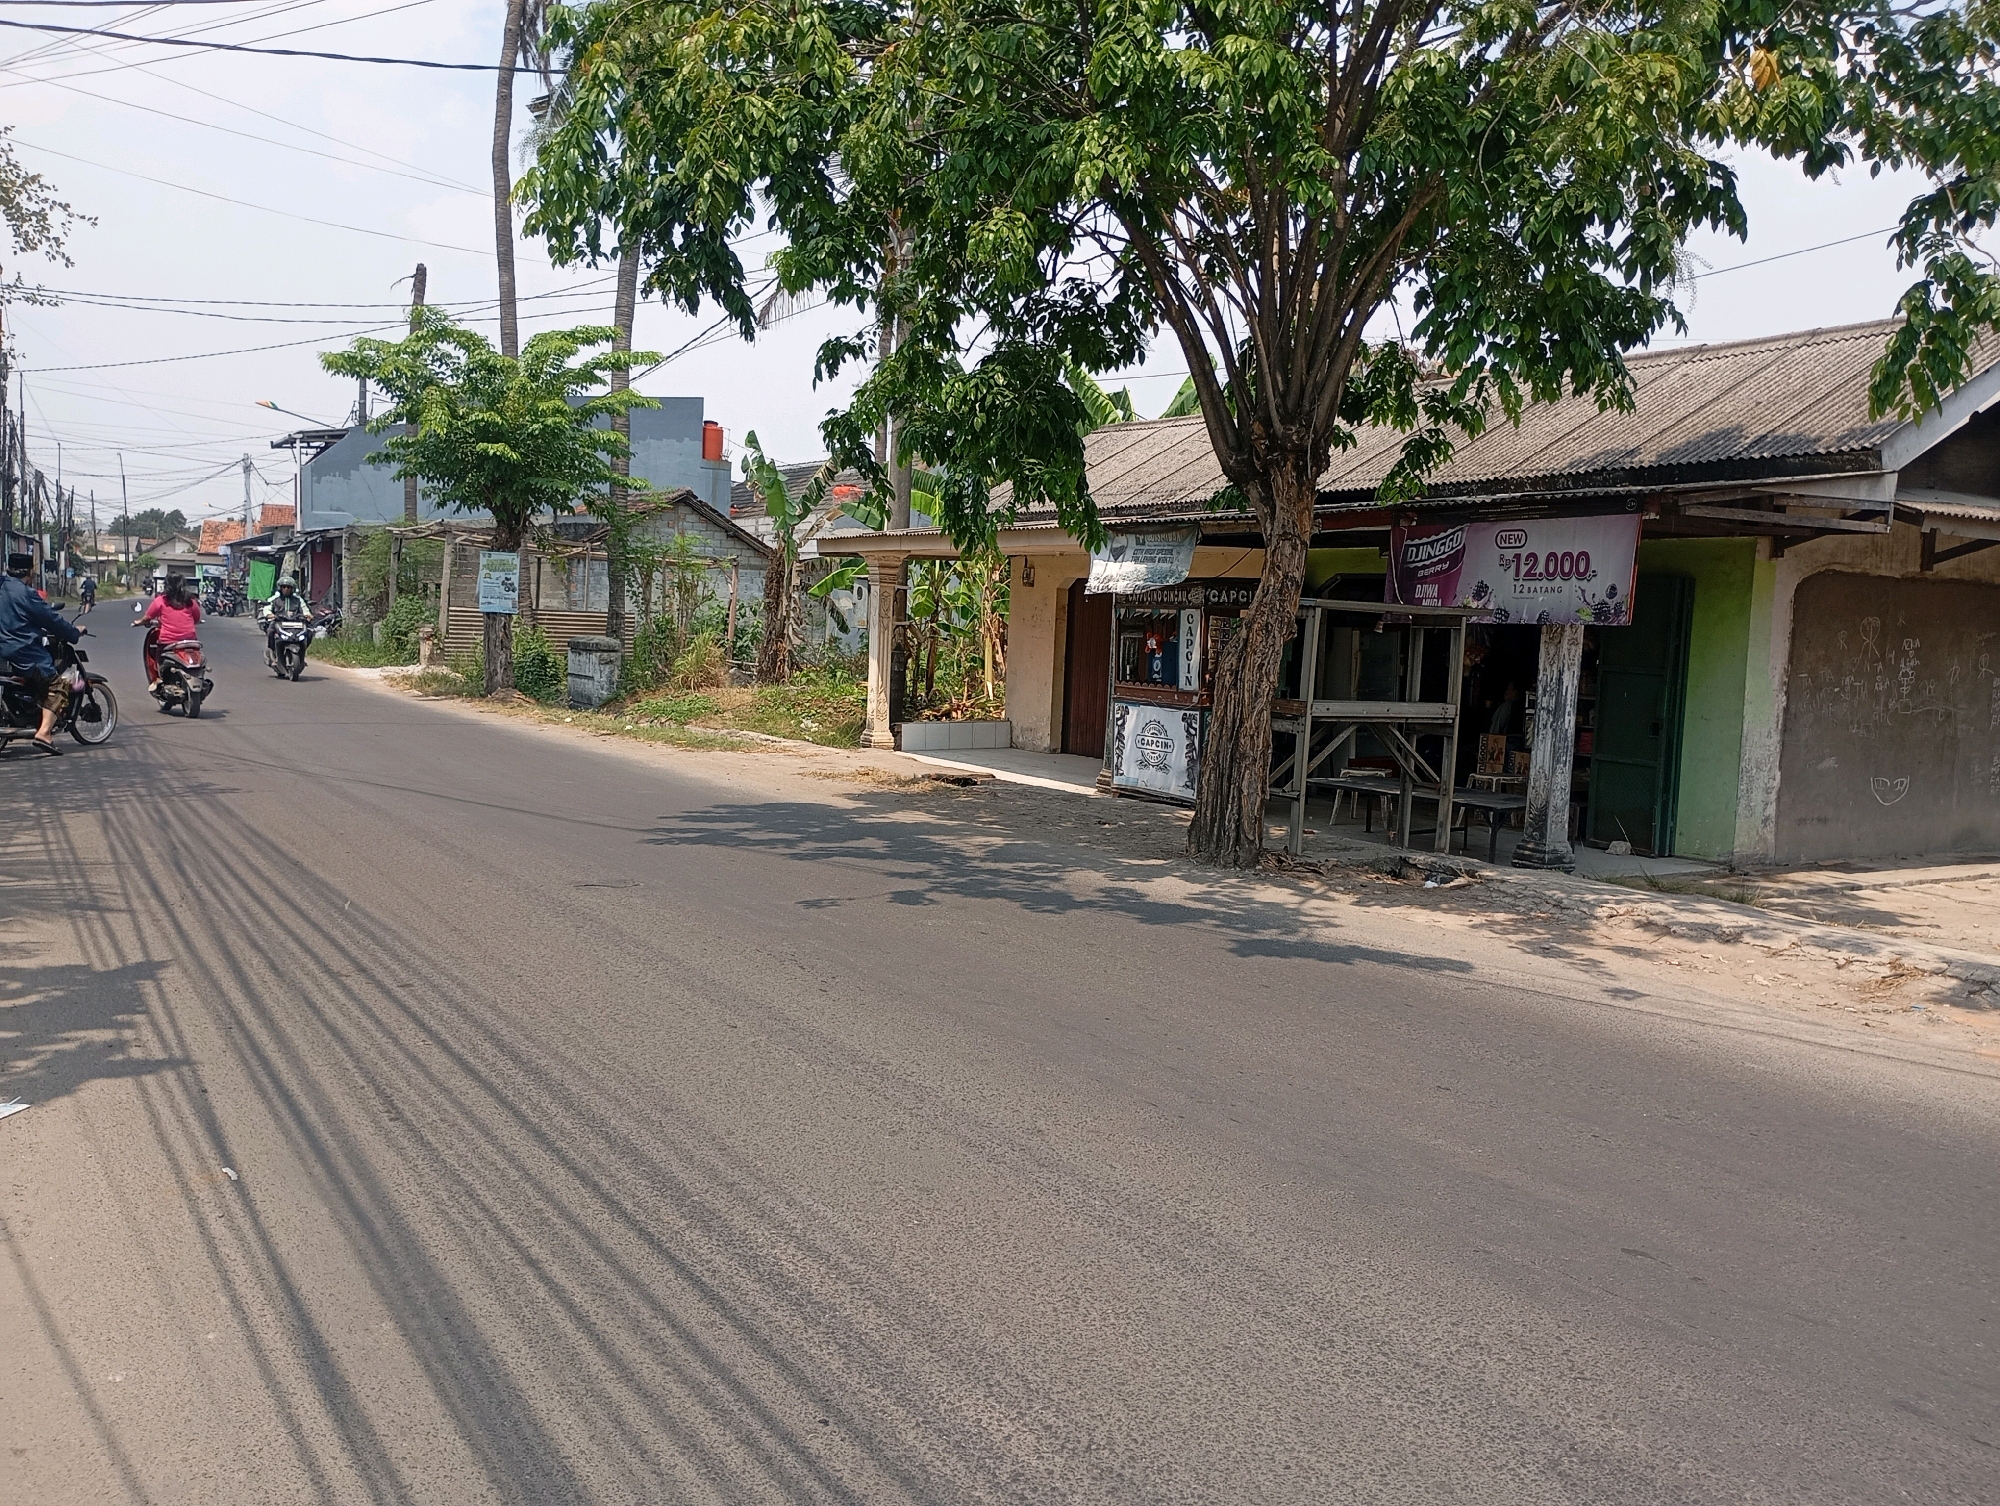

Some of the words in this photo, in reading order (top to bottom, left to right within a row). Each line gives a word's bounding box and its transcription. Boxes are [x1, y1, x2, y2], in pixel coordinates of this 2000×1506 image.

[1499, 532, 1524, 545] NEW
[1407, 531, 1463, 562] DJINGGO
[1417, 560, 1450, 578] BERRY
[1209, 589, 1252, 603] CAPCI
[1414, 584, 1439, 599] DJIWA
[1513, 584, 1525, 594] 12
[1527, 585, 1563, 594] BATANG
[1184, 613, 1195, 687] CAPCIN
[1141, 738, 1169, 750] CAPCIN
